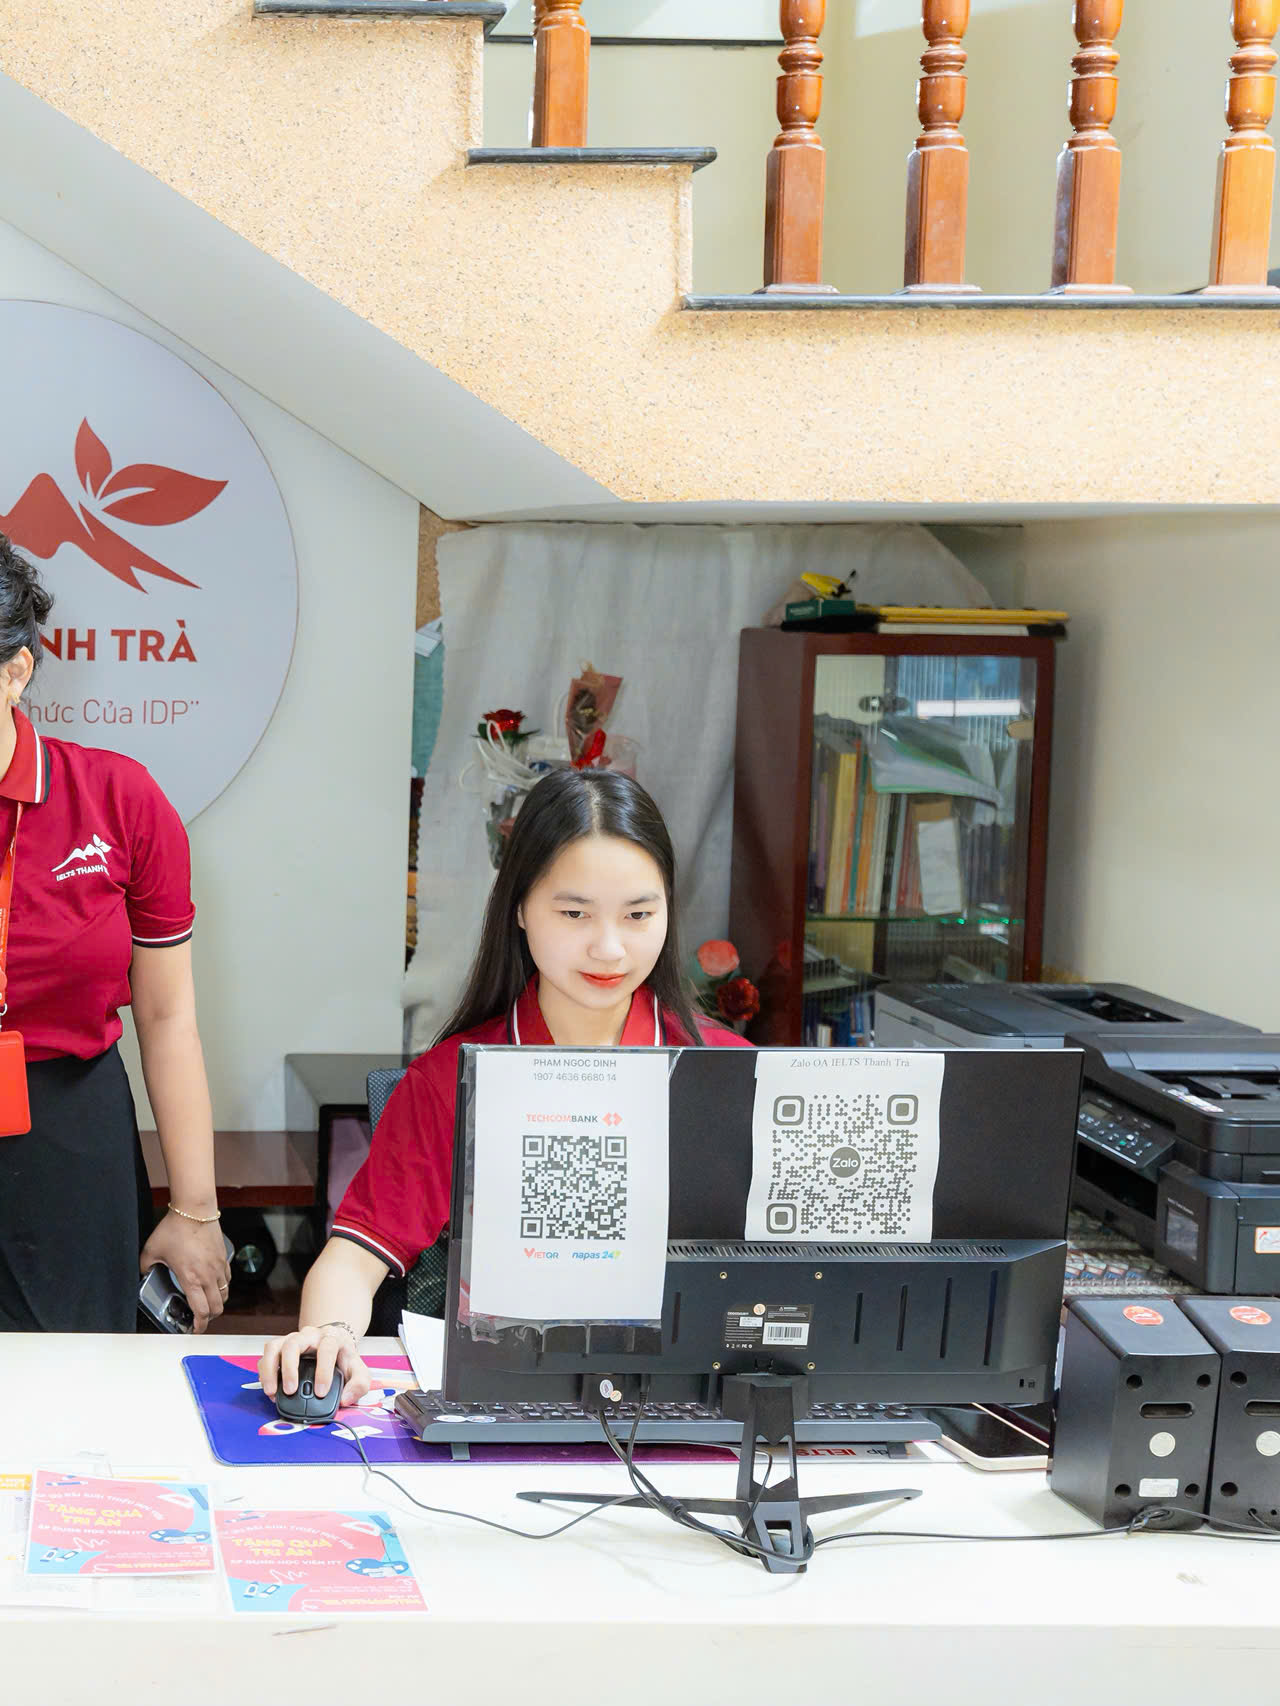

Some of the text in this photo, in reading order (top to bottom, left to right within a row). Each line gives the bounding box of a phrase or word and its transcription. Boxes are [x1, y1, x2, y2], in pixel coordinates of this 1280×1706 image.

[111, 620, 197, 662] TRÀ
[26, 699, 74, 723] hức
[83, 699, 133, 724] Của
[533, 1058, 617, 1068] PHAM NGOC DINH
[790, 1058, 811, 1068] Zalo
[813, 1059, 828, 1067] OA
[831, 1058, 860, 1067] IELTS
[863, 1057, 892, 1067] Thanh
[526, 1113, 599, 1123] TECHCOMBANK
[831, 1157, 859, 1168] Zalo
[572, 1251, 600, 1261] napas
[866, 1448, 889, 1456] dp
